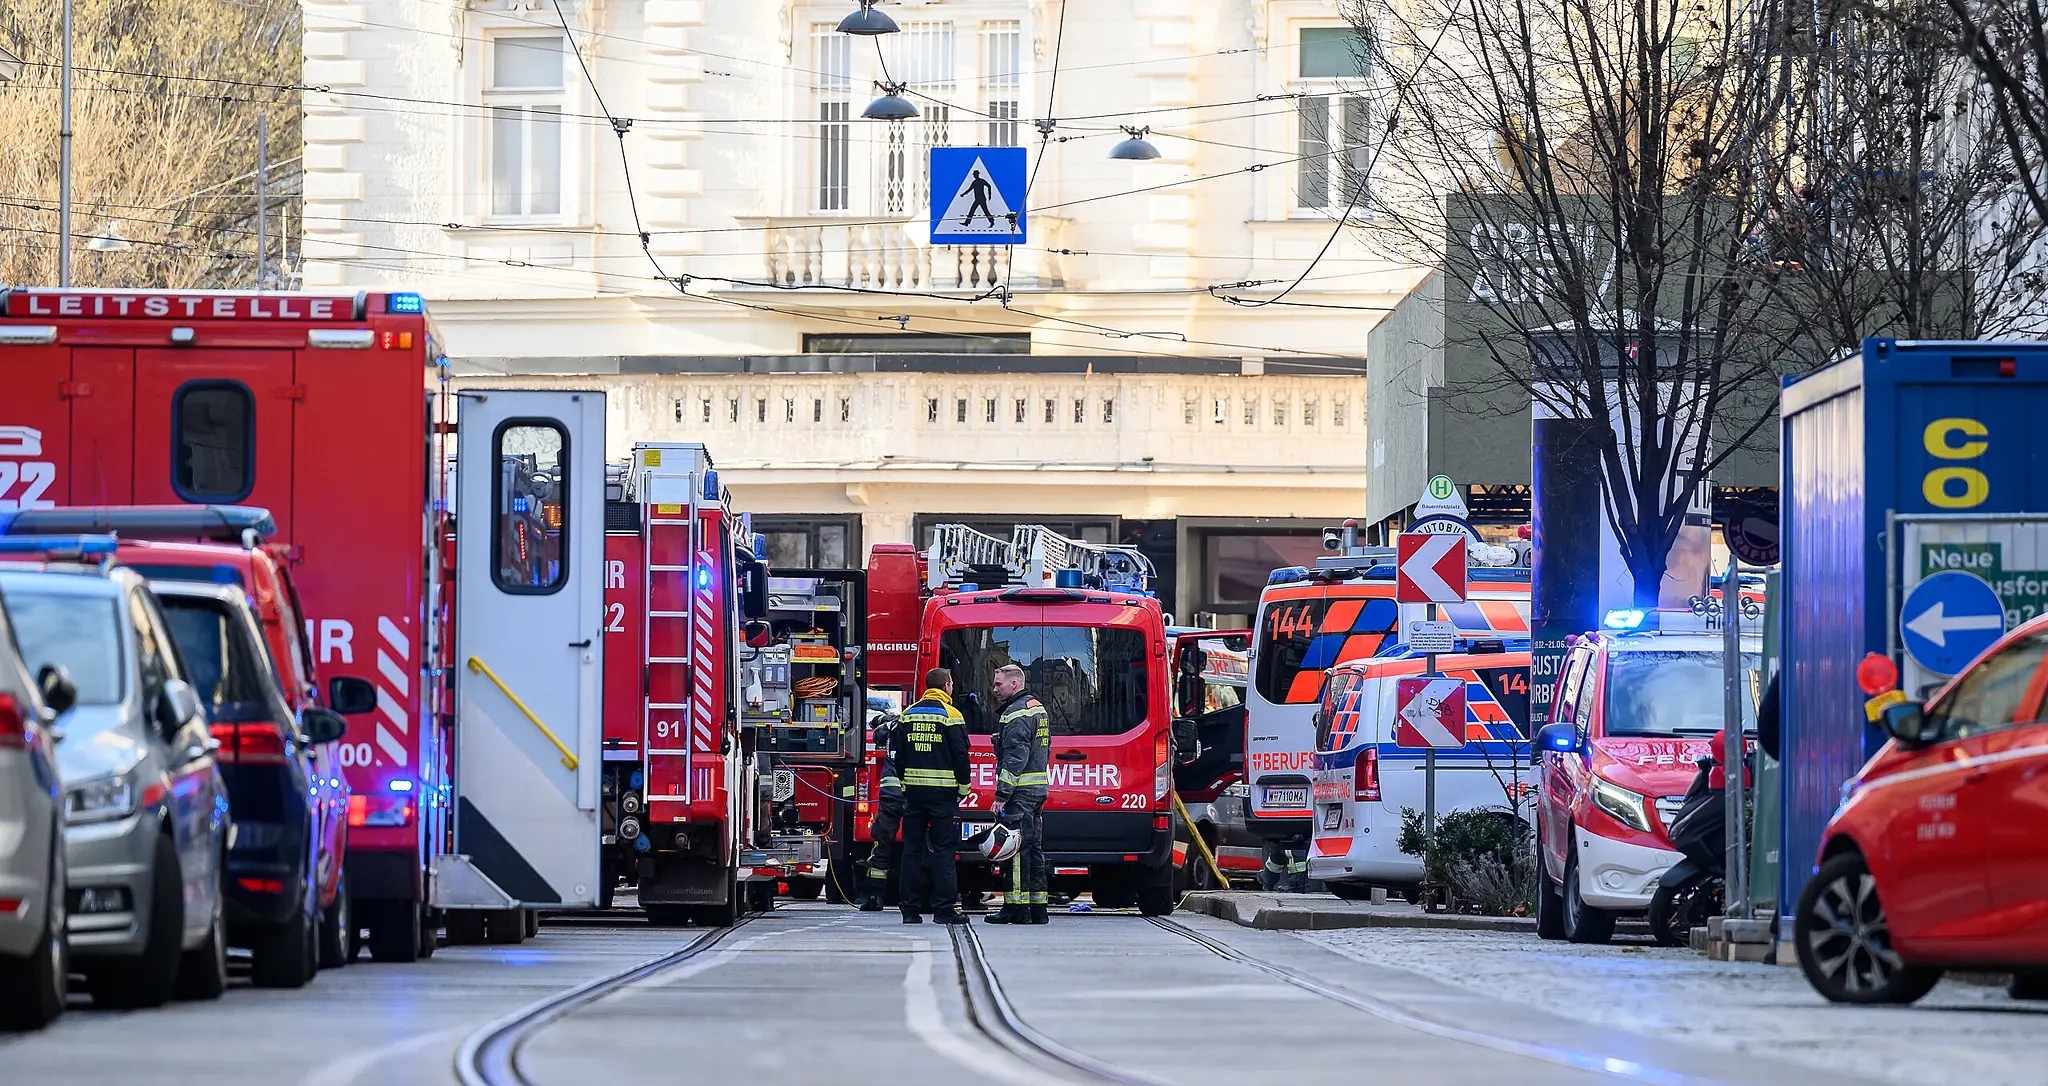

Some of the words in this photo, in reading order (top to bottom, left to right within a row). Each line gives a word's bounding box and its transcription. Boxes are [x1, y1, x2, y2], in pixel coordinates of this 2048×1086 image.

[29, 295, 334, 319] LEITSTELLE
[1417, 521, 1467, 534] UTOBU
[1928, 549, 1994, 568] Neue
[1270, 604, 1314, 641] 144
[866, 643, 918, 651] MAGIRUS
[1498, 673, 1531, 695] 14
[656, 720, 680, 738] 91
[912, 722, 937, 732] BERUFS
[914, 742, 932, 752] WIEN
[1263, 751, 1314, 771] BERUFS
[1121, 793, 1147, 809] 220
